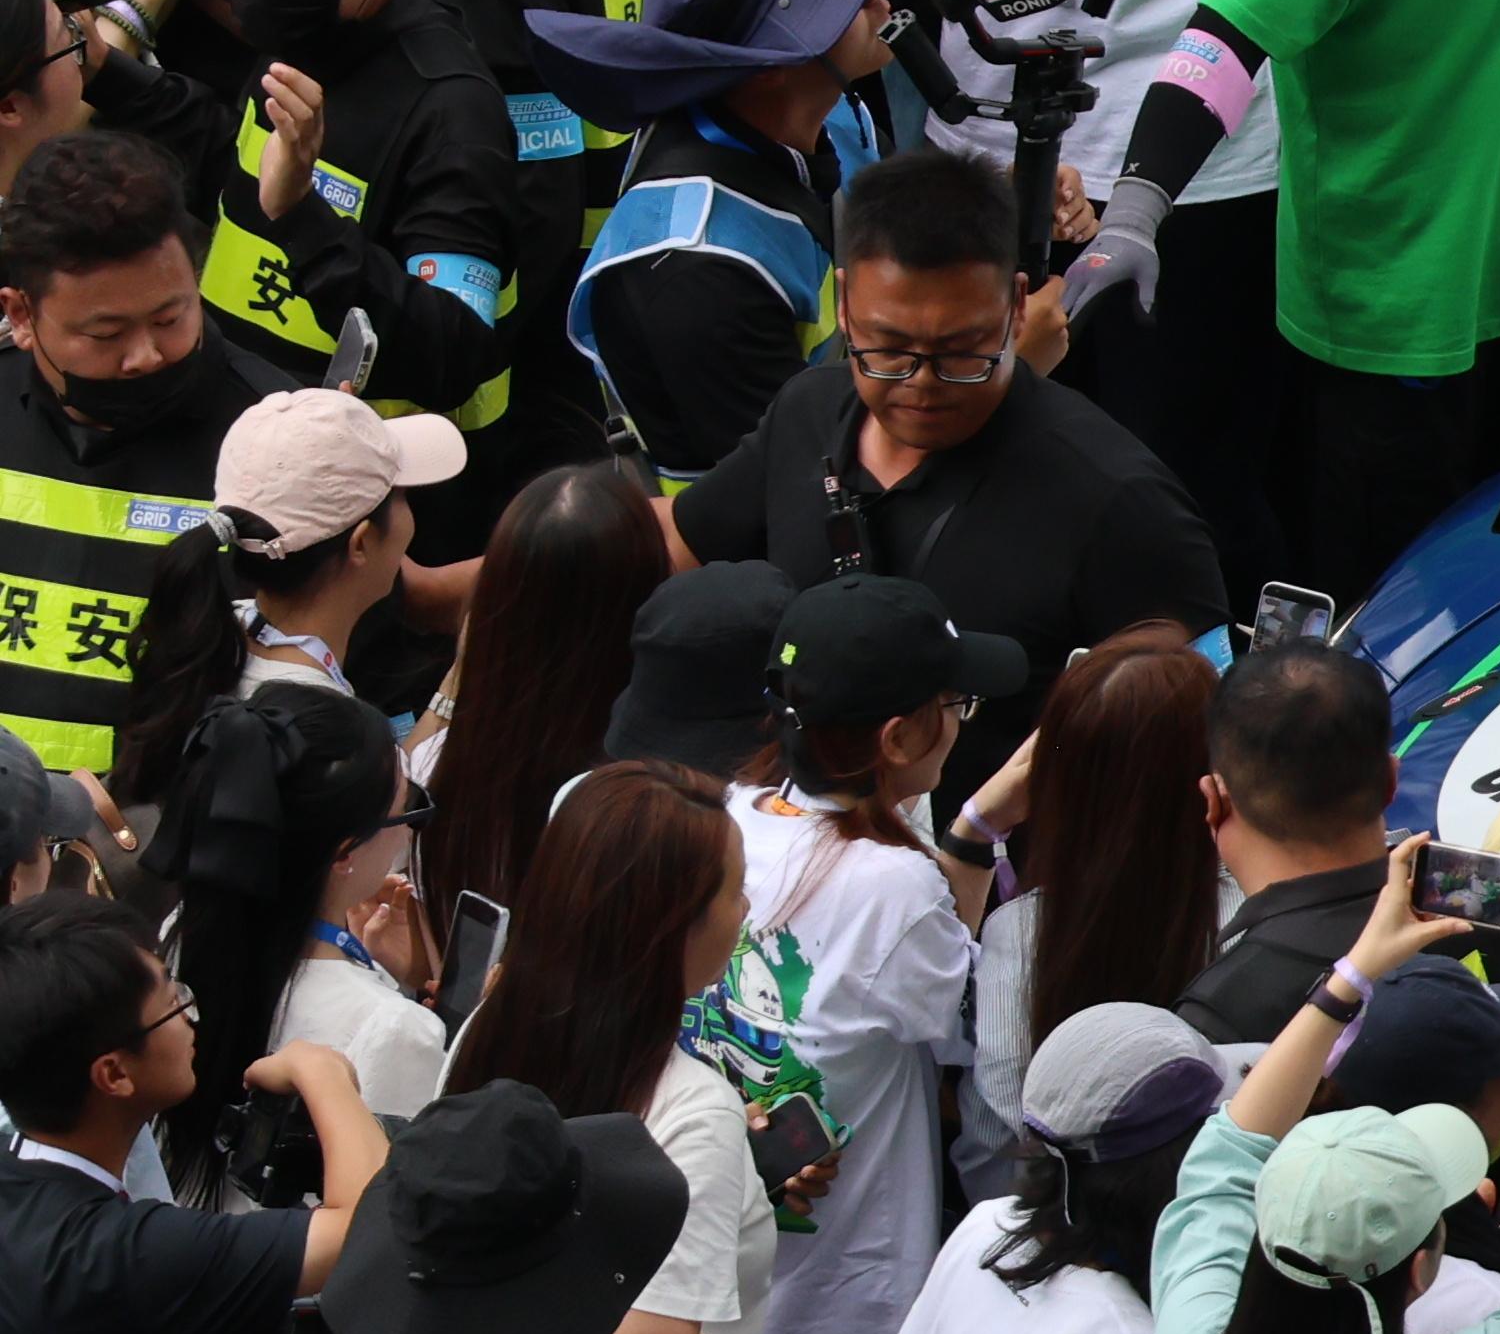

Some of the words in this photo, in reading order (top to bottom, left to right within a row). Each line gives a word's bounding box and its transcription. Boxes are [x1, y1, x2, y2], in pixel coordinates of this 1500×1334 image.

[519, 127, 576, 150] ICIAL
[322, 184, 357, 209] GRID
[130, 510, 171, 528] GRID
